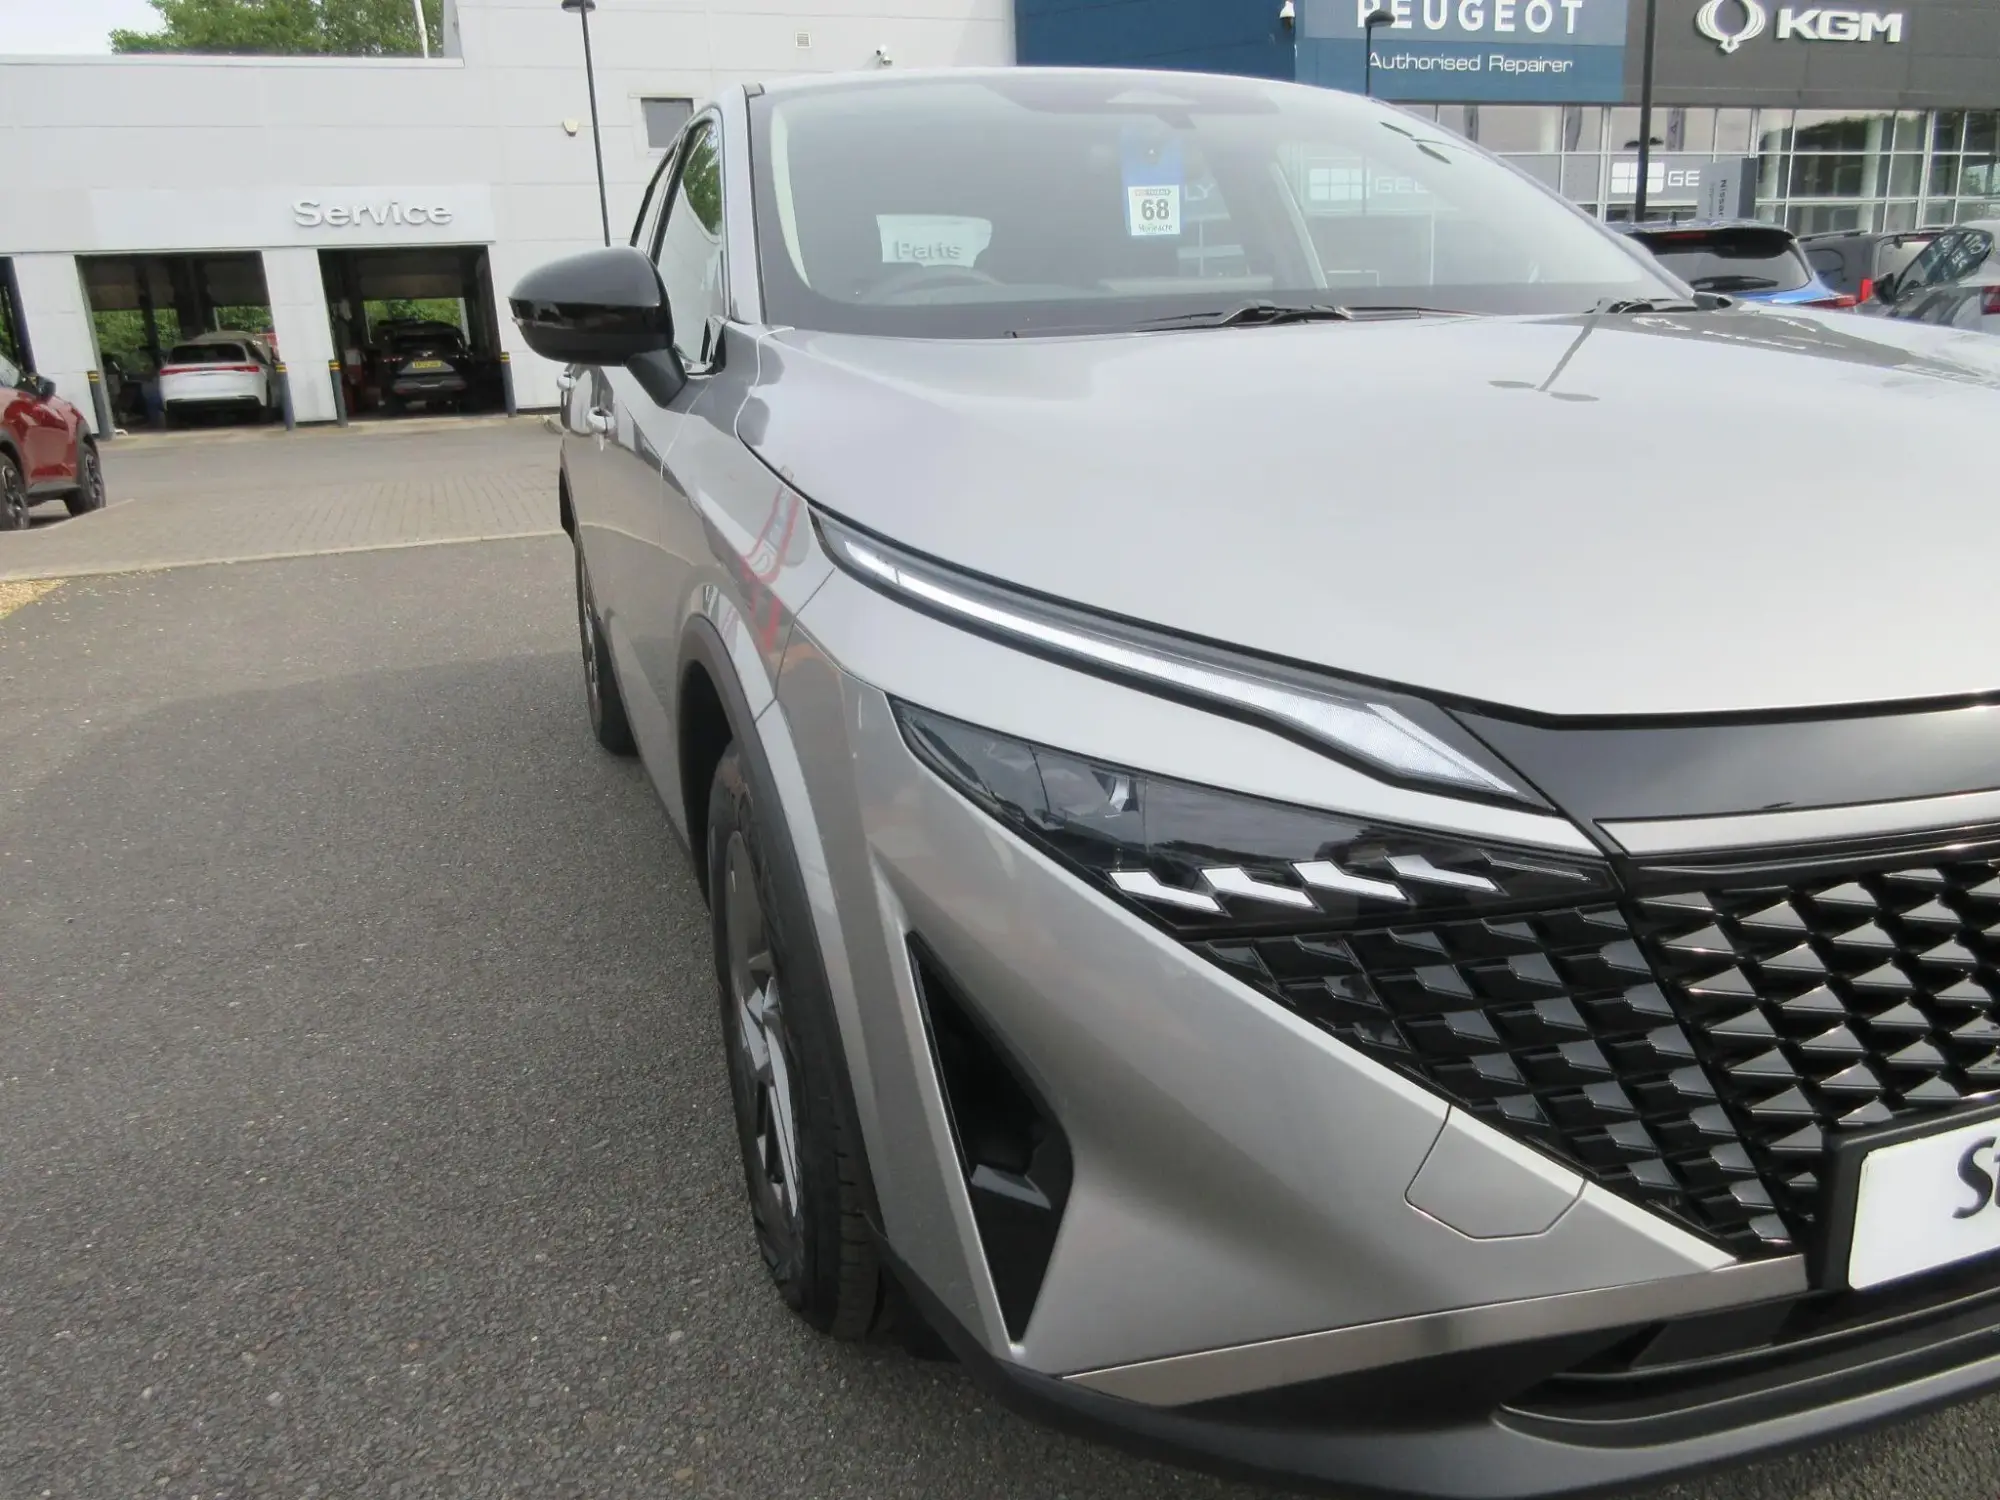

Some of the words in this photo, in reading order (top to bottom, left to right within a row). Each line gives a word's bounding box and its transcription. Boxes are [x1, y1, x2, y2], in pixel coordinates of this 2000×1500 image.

[1357, 0, 1583, 34] PEUGEOT
[1777, 8, 1903, 42] KGM
[1368, 51, 1481, 71] Authorised
[1488, 54, 1573, 76] Repairer
[293, 199, 453, 228] Service
[1141, 198, 1170, 221] 68
[893, 240, 962, 260] Parts
